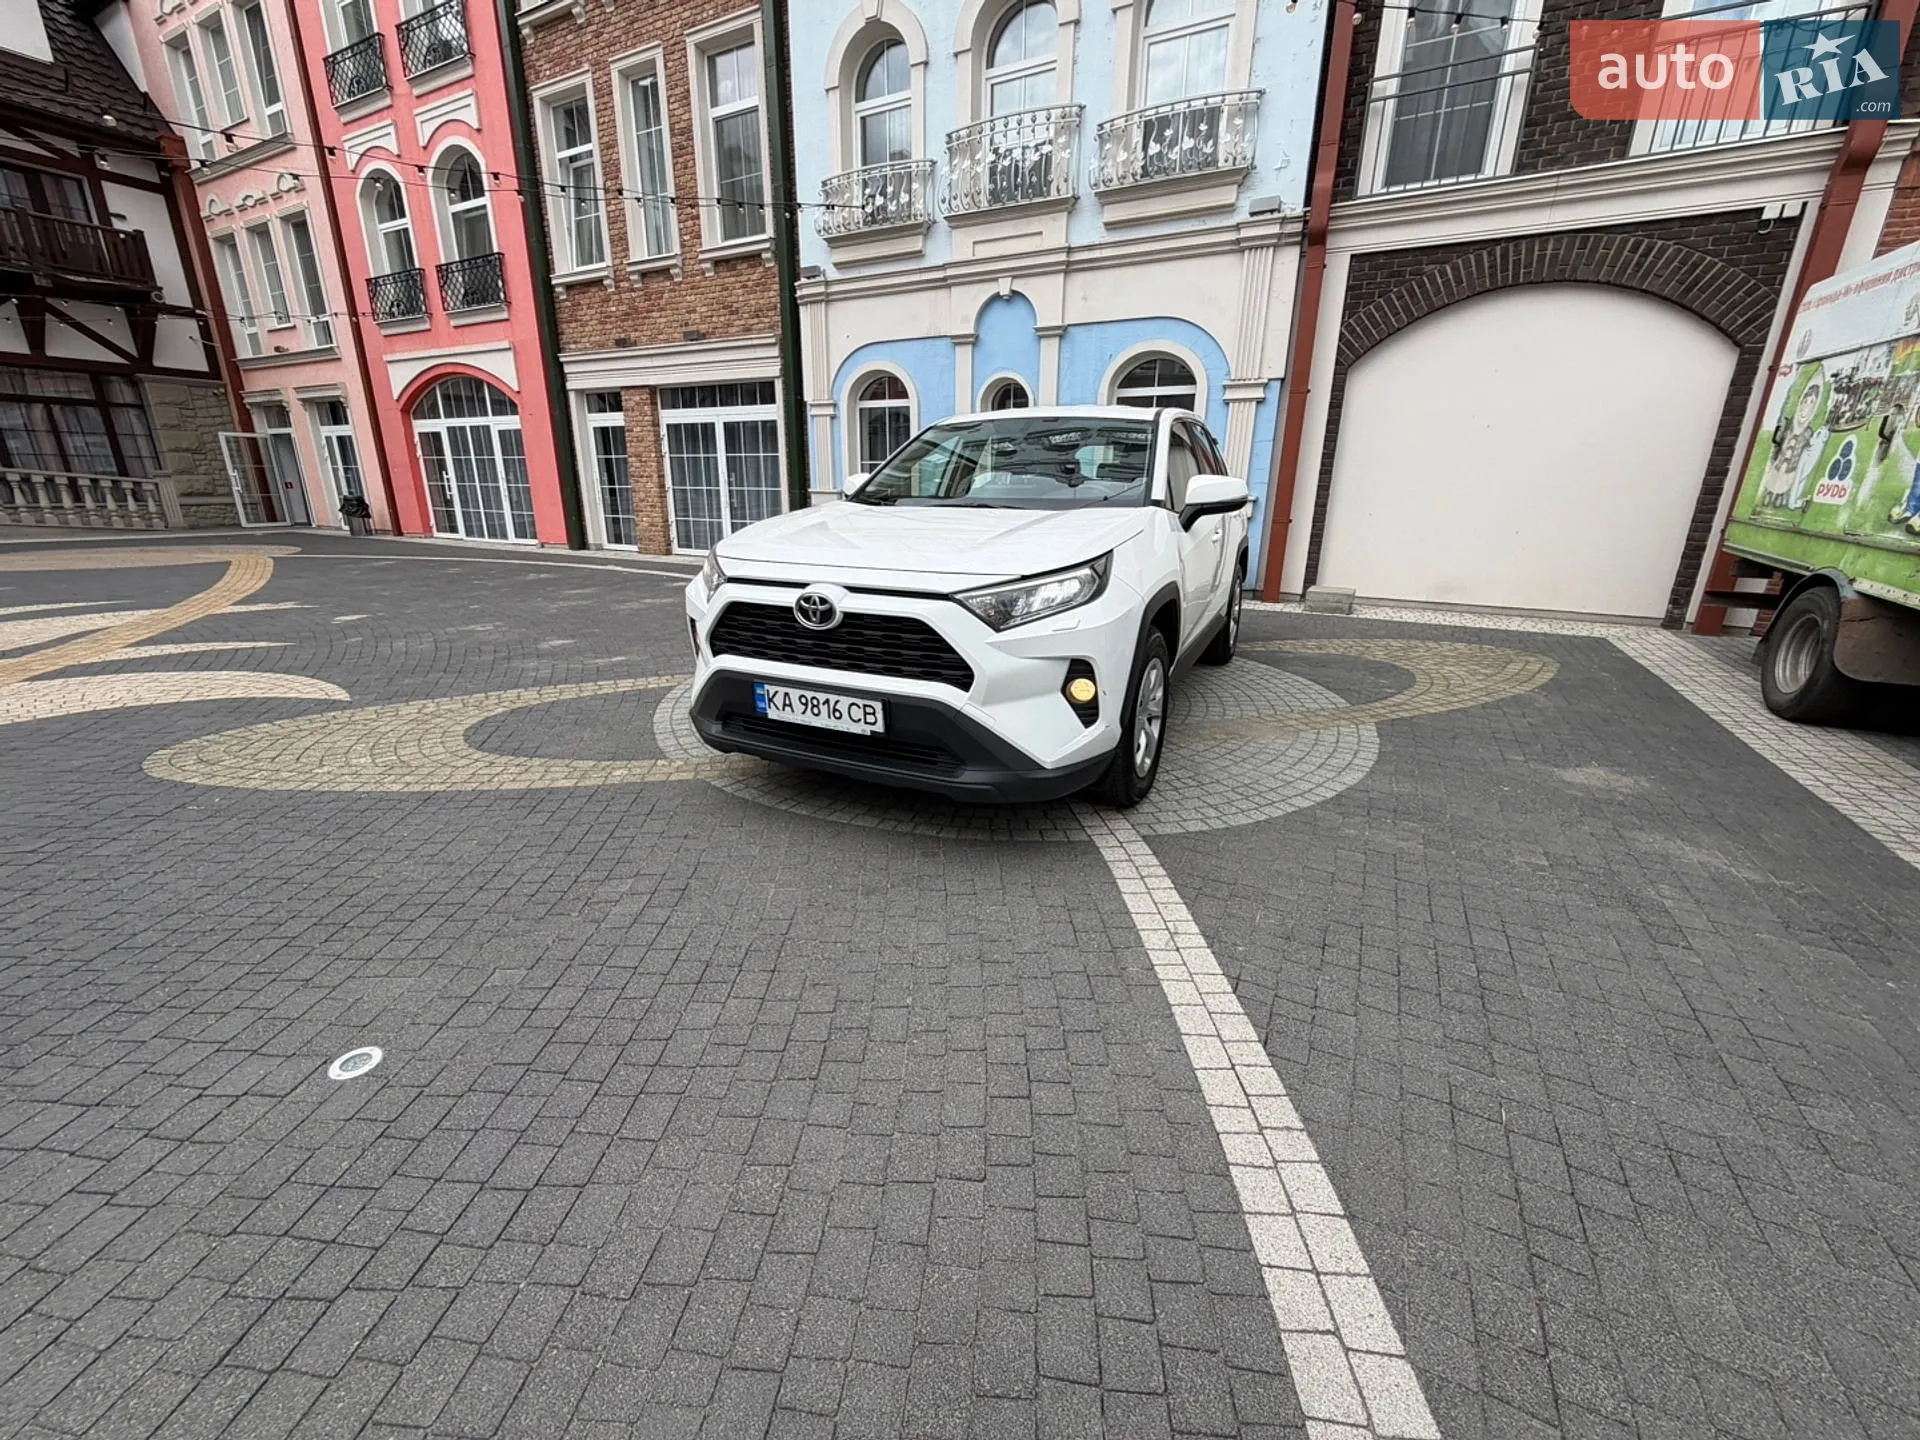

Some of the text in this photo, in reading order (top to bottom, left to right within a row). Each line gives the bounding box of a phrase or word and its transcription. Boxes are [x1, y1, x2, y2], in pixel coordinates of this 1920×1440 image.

[766, 689, 795, 713] KA
[798, 694, 843, 720] 9816
[847, 702, 878, 726] CB
